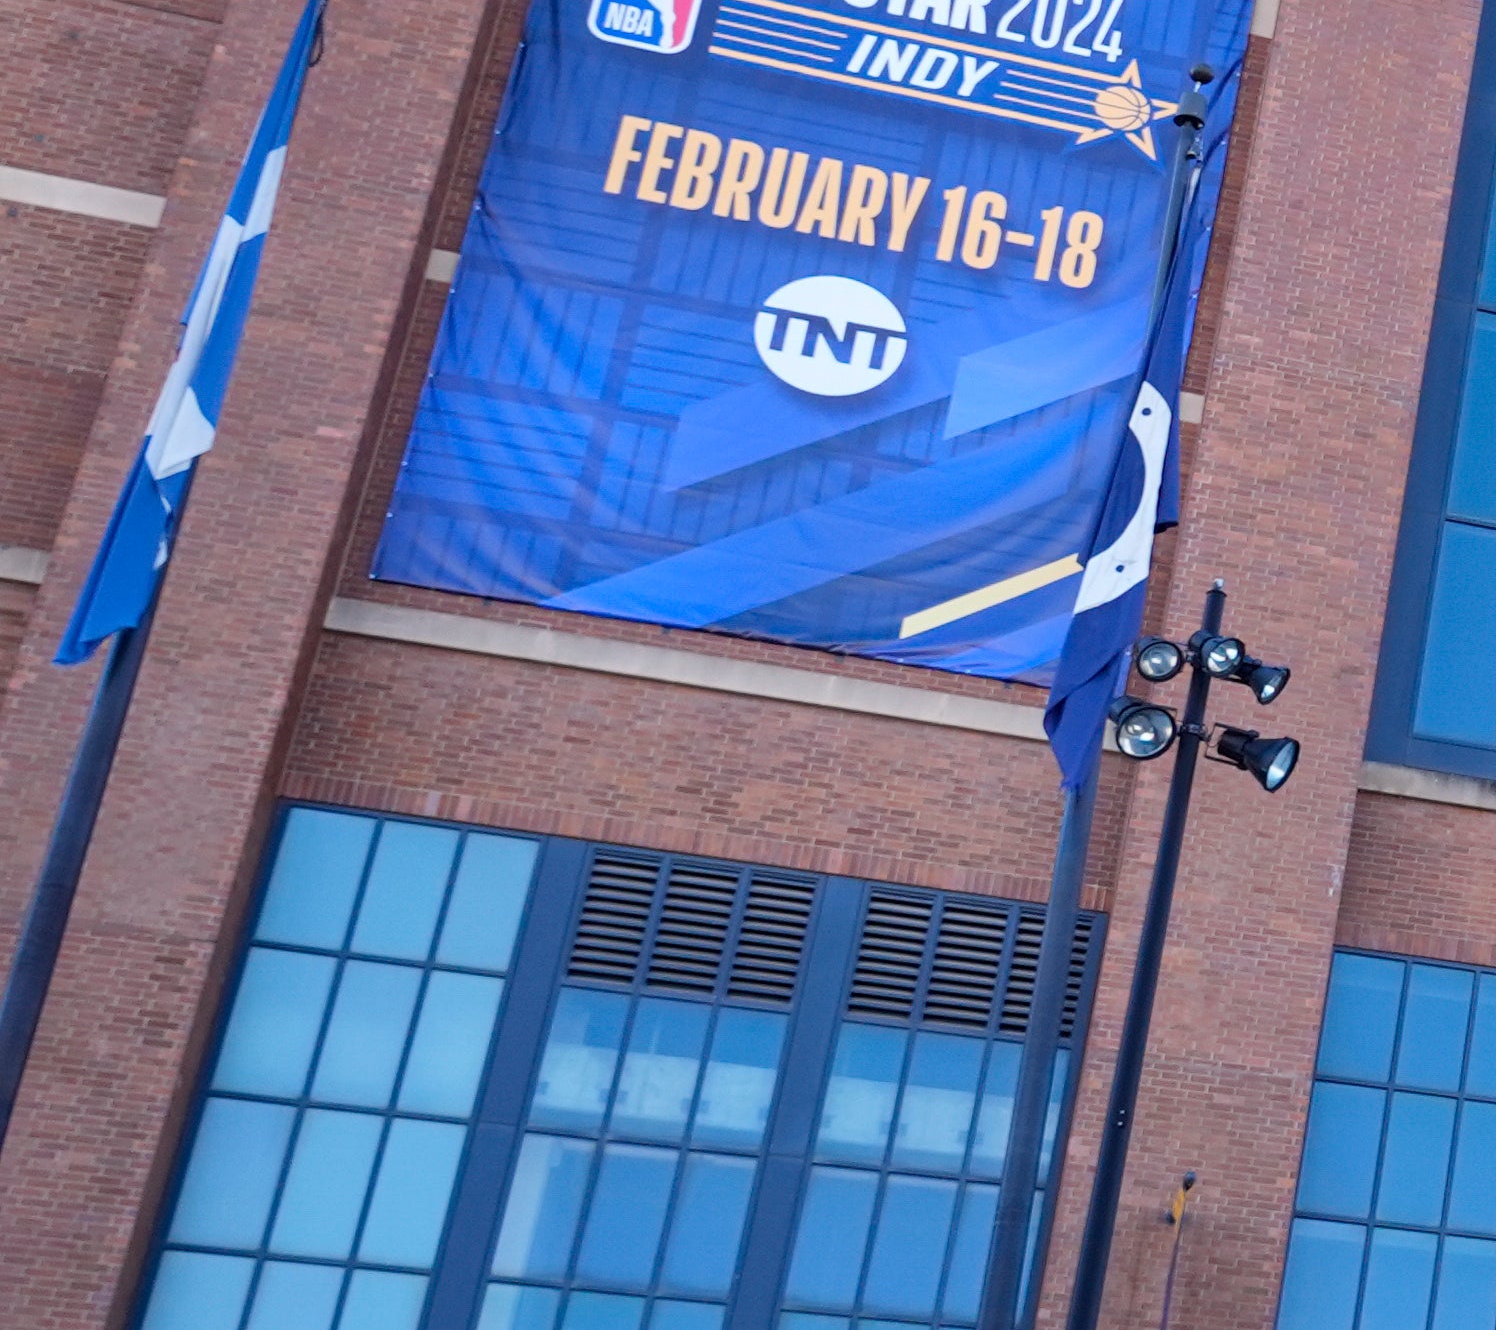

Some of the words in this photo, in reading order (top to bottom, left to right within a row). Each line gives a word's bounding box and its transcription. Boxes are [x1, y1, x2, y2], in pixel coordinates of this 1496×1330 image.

[605, 1, 655, 39] NBA
[845, 33, 1001, 99] INDY
[602, 113, 933, 254] FEBRUARY
[935, 185, 1104, 290] 16-18
